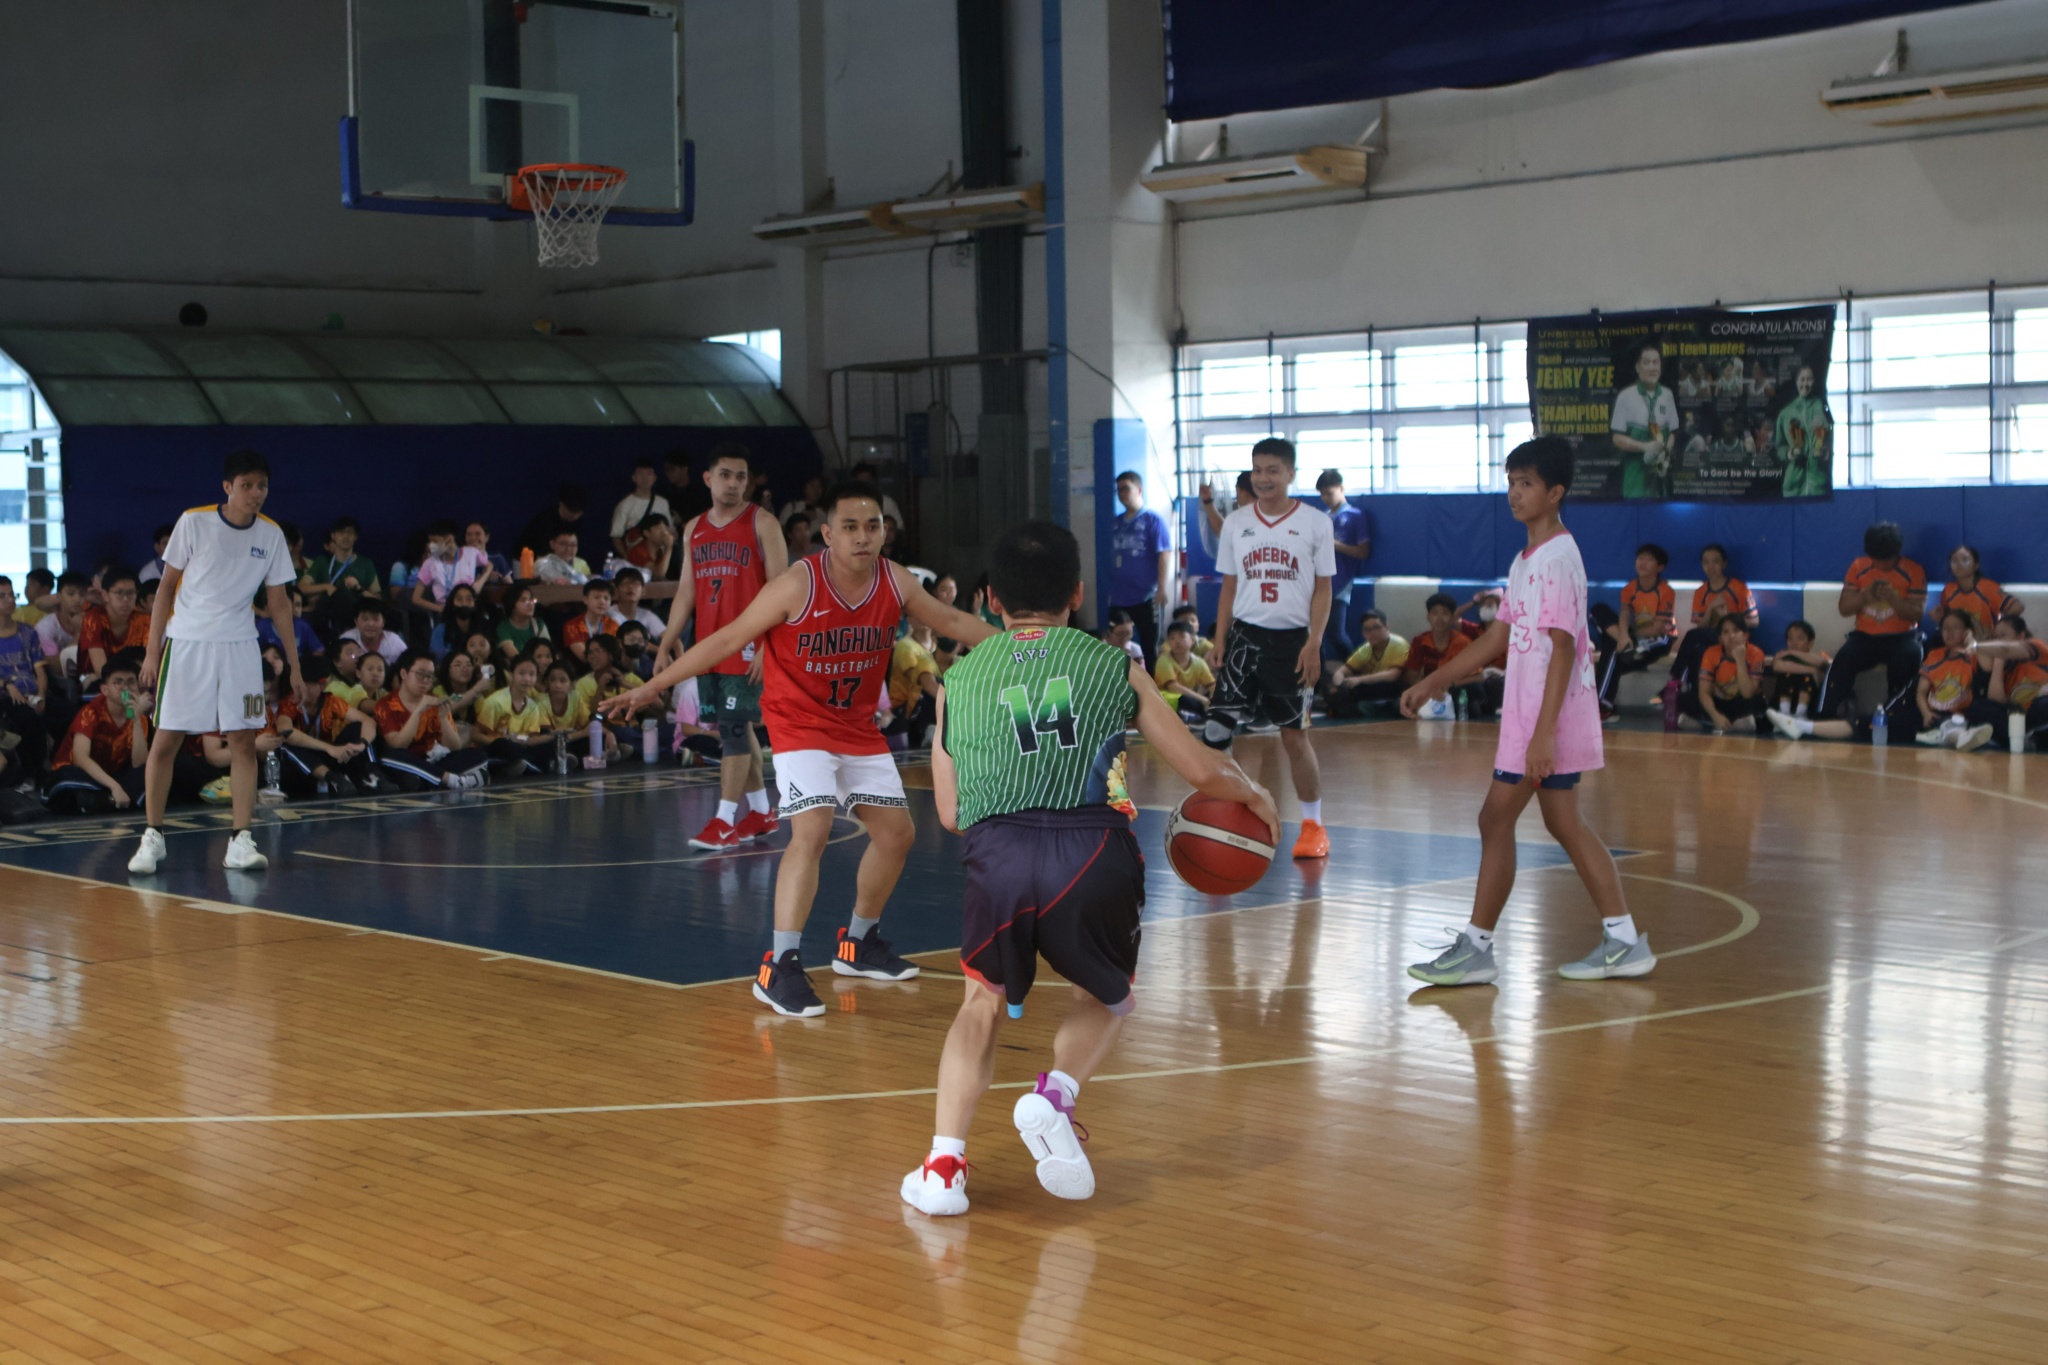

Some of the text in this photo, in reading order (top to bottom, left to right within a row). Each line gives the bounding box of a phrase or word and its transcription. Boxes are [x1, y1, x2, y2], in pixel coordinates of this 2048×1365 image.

[1600, 326, 1648, 337] WINNING
[1711, 320, 1826, 336] CONGRATULATIONS!
[1662, 342, 1678, 357] his
[1709, 341, 1745, 355] mates
[1535, 365, 1615, 389] JERRY YEE
[1537, 404, 1609, 421] CHAMPION
[1553, 424, 1575, 434] LADY
[1576, 423, 1609, 434] BLAZERS
[1700, 469, 1709, 478] To
[1710, 468, 1728, 478] God
[1730, 469, 1742, 478] be
[1744, 469, 1757, 478] the
[1759, 468, 1783, 479] Glory!
[1243, 546, 1299, 574] GINEBRA
[1246, 568, 1298, 580] SAN MIGUEL
[710, 579, 722, 604] 7
[1260, 582, 1279, 603] 15
[796, 626, 896, 658] PANGHULO
[806, 655, 879, 675] BASKETBALL
[1012, 648, 1050, 665] RYU
[827, 676, 862, 710] 17
[243, 693, 265, 719] 10
[1000, 675, 1079, 756] 14
